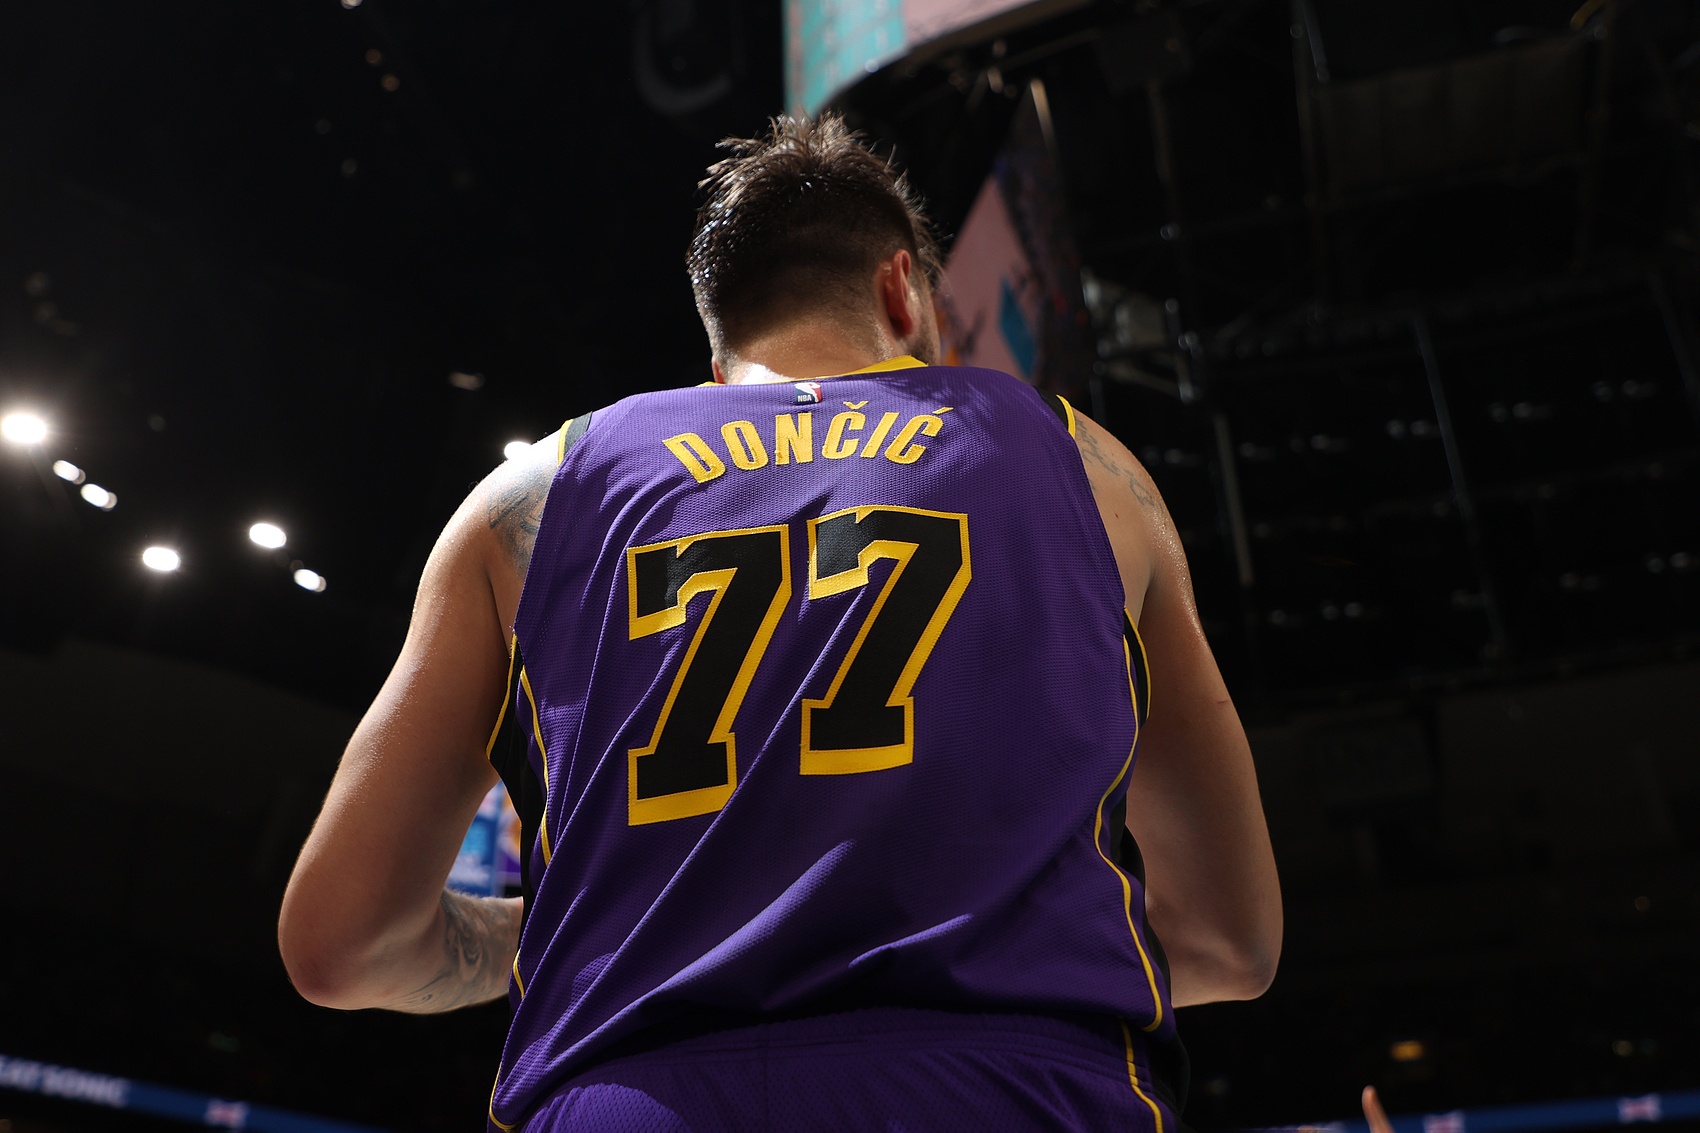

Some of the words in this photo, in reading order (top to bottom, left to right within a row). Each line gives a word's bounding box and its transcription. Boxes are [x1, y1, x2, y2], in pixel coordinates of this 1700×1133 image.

[797, 394, 812, 403] NBA
[662, 400, 954, 484] DONČIĆ
[626, 504, 973, 827] 77
